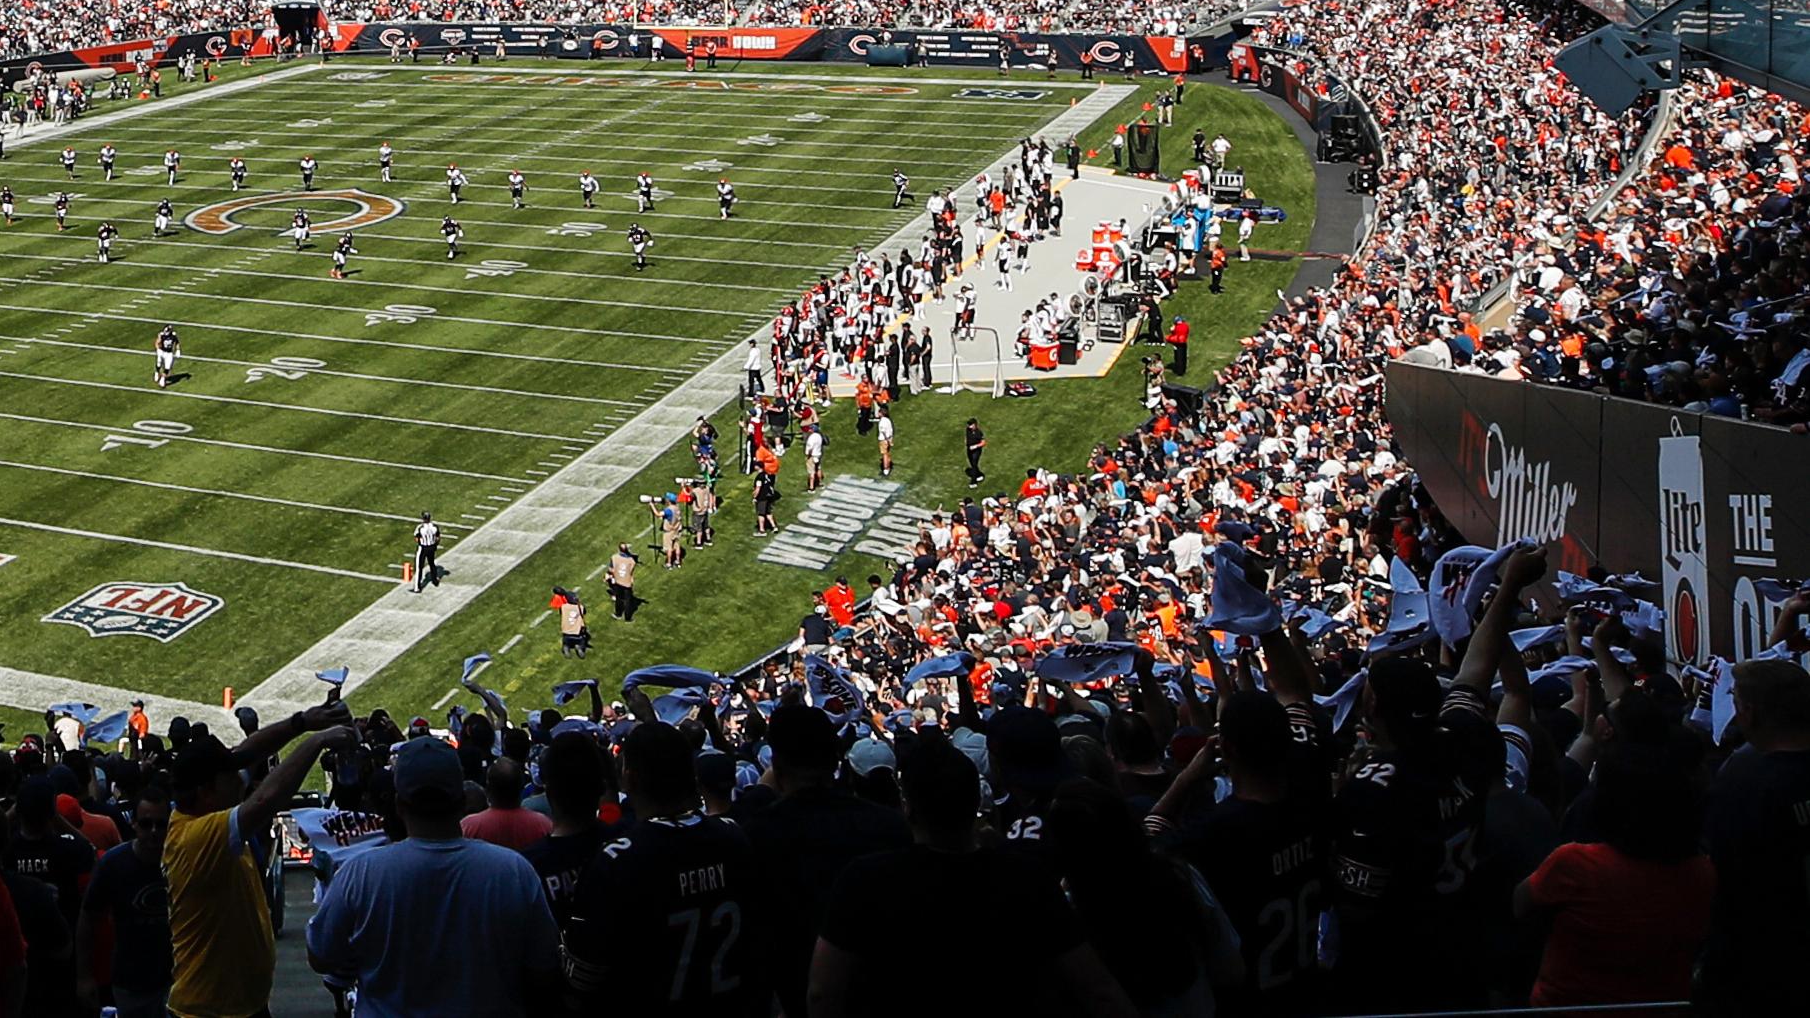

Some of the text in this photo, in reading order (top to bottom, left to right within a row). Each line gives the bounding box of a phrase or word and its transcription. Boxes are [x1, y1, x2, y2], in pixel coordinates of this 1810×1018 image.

[732, 35, 776, 50] DOWN
[364, 303, 438, 327] 30
[244, 356, 328, 384] 20
[99, 419, 193, 452] 10
[1485, 422, 1577, 551] Miller
[757, 473, 903, 571] WELCOME
[1662, 488, 1702, 572] Lite
[1728, 493, 1775, 552] THE
[98, 586, 204, 623] NFL
[1354, 762, 1397, 789] 52
[1005, 814, 1045, 841] 32
[16, 857, 49, 874] MACK
[1271, 833, 1316, 877] ORTIZ
[678, 862, 727, 898] PERRY
[666, 899, 742, 1006] 72
